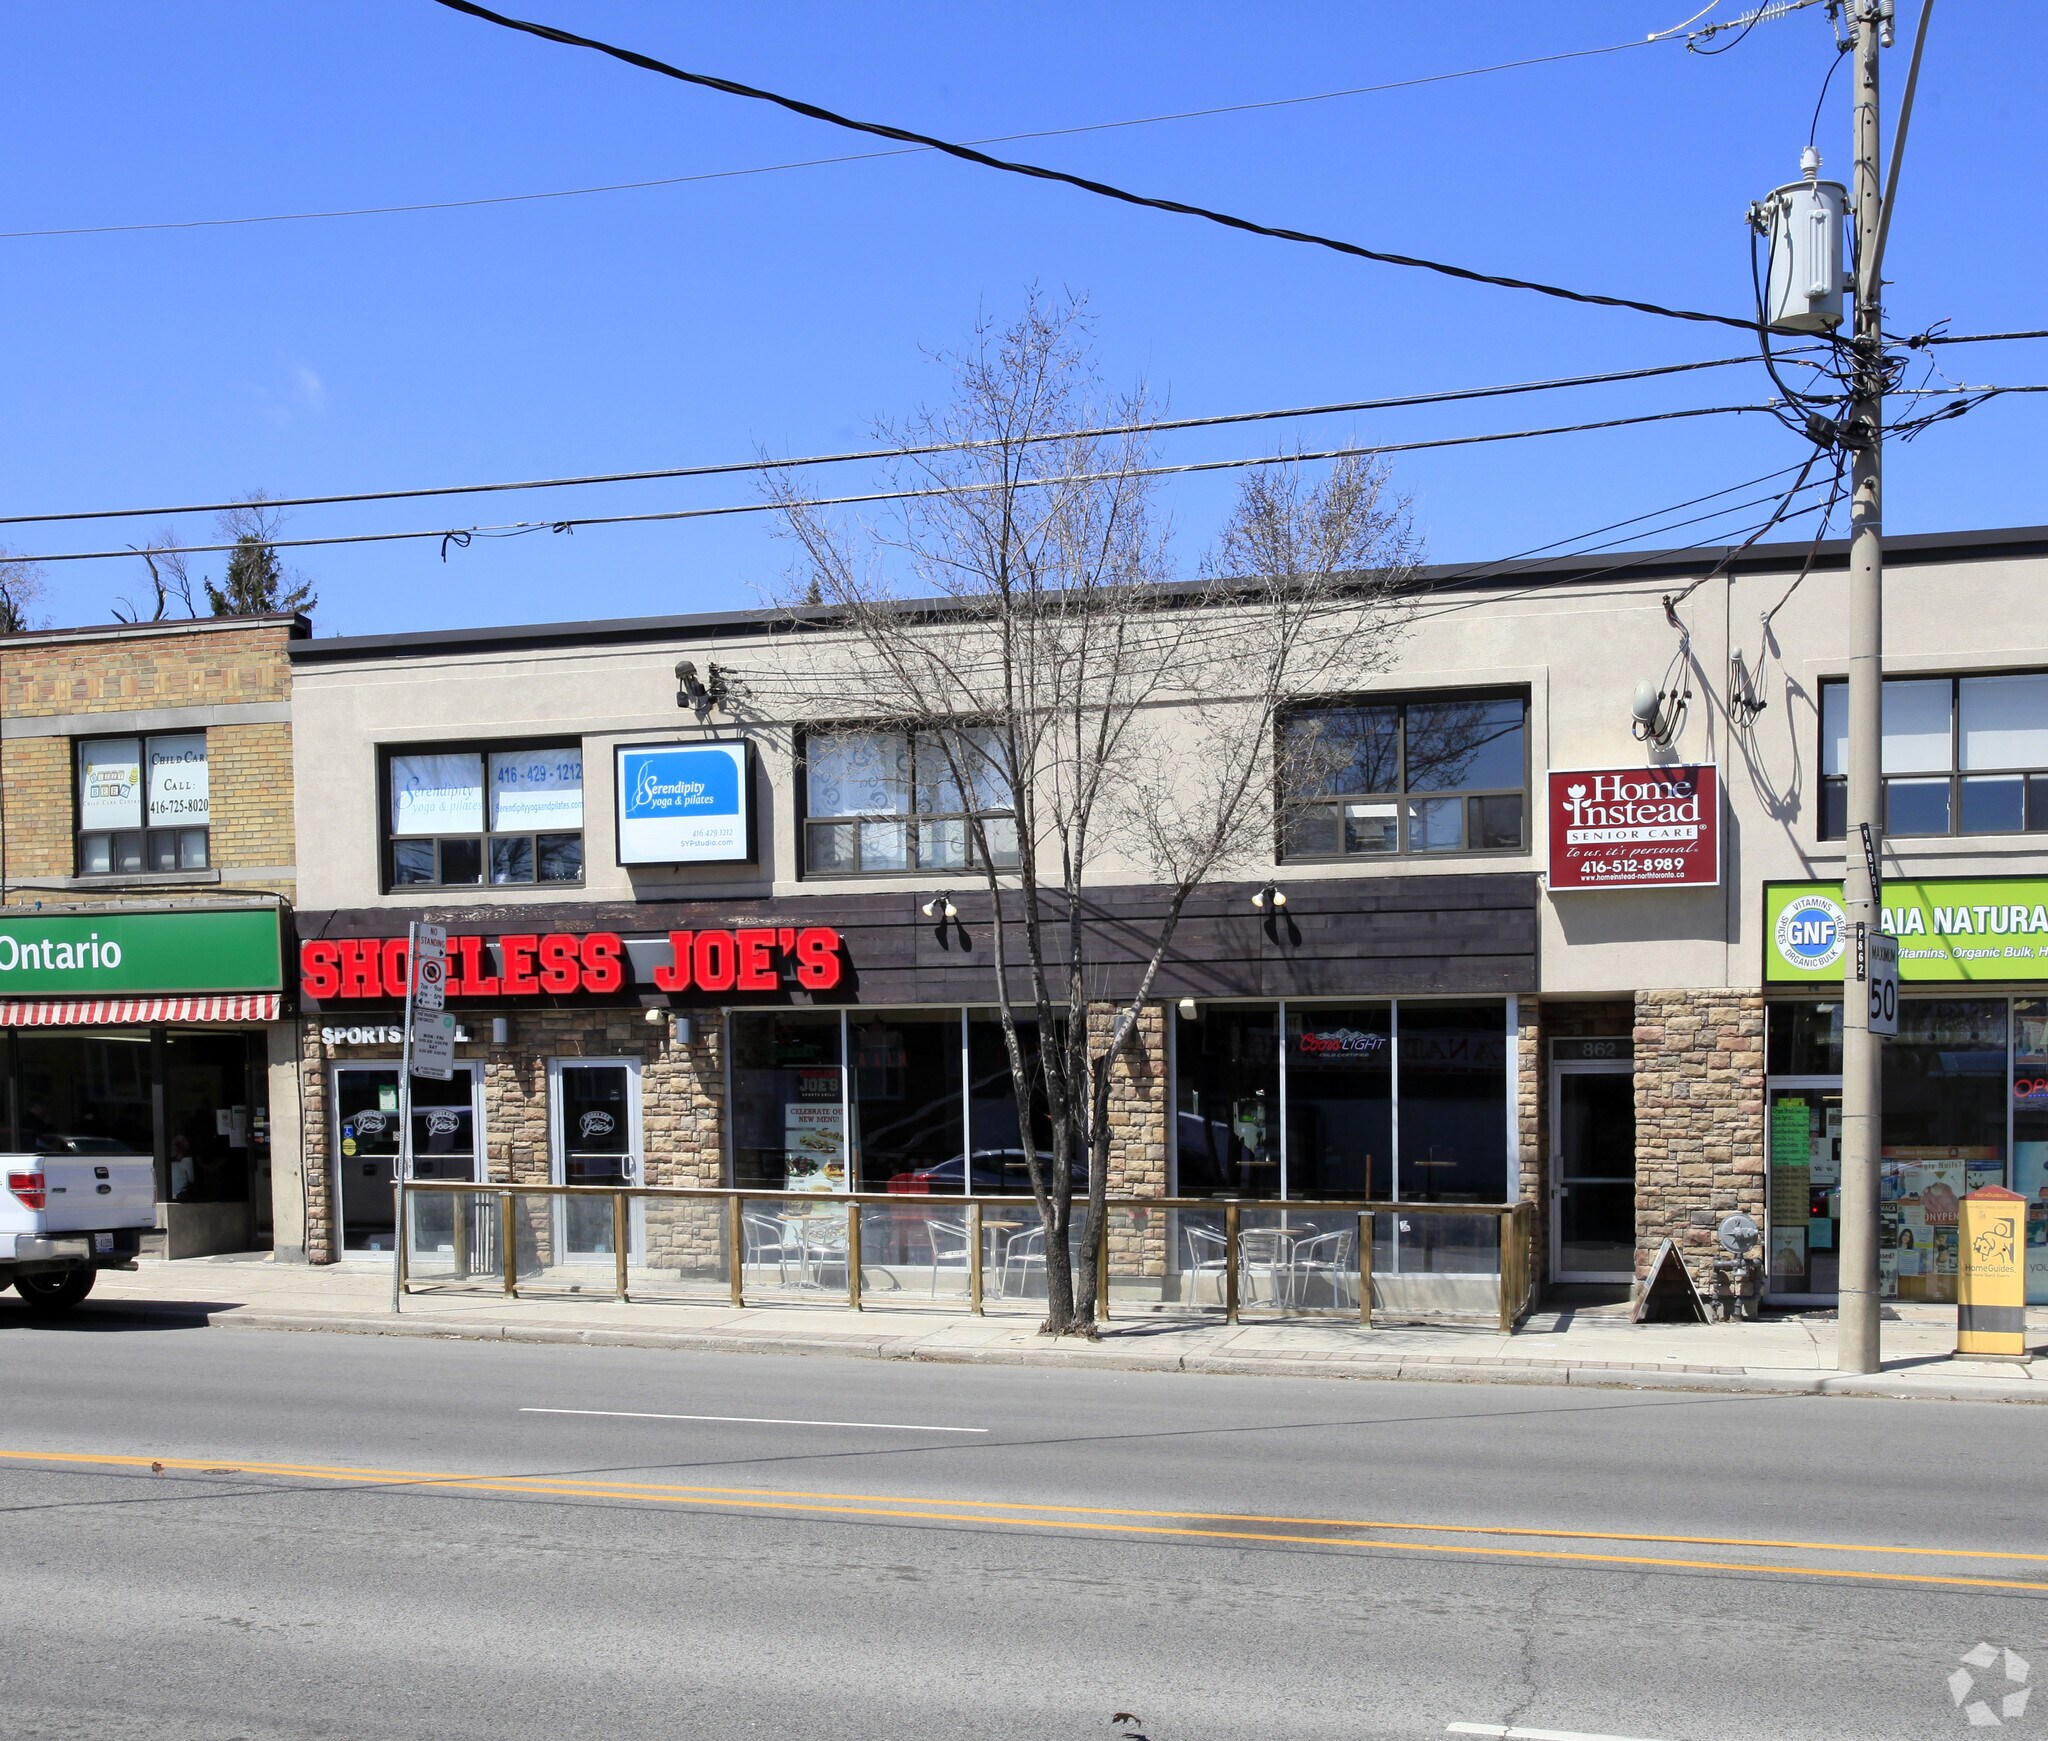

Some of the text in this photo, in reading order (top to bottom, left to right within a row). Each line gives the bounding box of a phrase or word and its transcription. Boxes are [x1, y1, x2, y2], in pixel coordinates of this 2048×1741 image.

[498, 767, 517, 783] 416
[527, 765, 546, 782] 429
[557, 763, 582, 780] 1212
[164, 779, 196, 791] CALL:
[396, 776, 474, 809] Serendipity
[636, 775, 705, 805] Serendipity
[1592, 775, 1693, 802] Home
[150, 799, 208, 814] 416-725-8020
[412, 800, 481, 815] yoga & pilates
[651, 795, 714, 809] yoga & pilates
[1569, 794, 1701, 827] Instead
[1572, 828, 1693, 840] SENIOR CARE
[680, 839, 733, 847] SYPstudio.com
[1605, 845, 1626, 856] it's
[1580, 858, 1685, 873] 416-512-8989
[1581, 871, 1685, 881] www.homeinstead-northtoronto.ca
[1792, 898, 1833, 912] VITAMINS
[430, 927, 438, 936] NO
[1778, 915, 1789, 945] SPICES
[1788, 921, 1835, 945] GNF
[1835, 915, 1846, 944] HERBS
[420, 937, 445, 948] STANDING
[0, 932, 122, 971] Ontario
[1785, 949, 1839, 967] ORGANIC BULK
[1871, 944, 1896, 964] MAXIMUM
[1952, 947, 2001, 960] Organic
[2003, 946, 2034, 958] Bulk,
[652, 927, 844, 995] JOE'S
[1871, 978, 1895, 1022] 50
[321, 1025, 402, 1045] SPORTS
[1299, 1032, 1386, 1051] Coors LIGHT
[1583, 1042, 1617, 1057] 862
[799, 1078, 839, 1092] JOE'S
[2014, 1078, 2048, 1098] OP
[1965, 1264, 2015, 1272] HomeGuides
